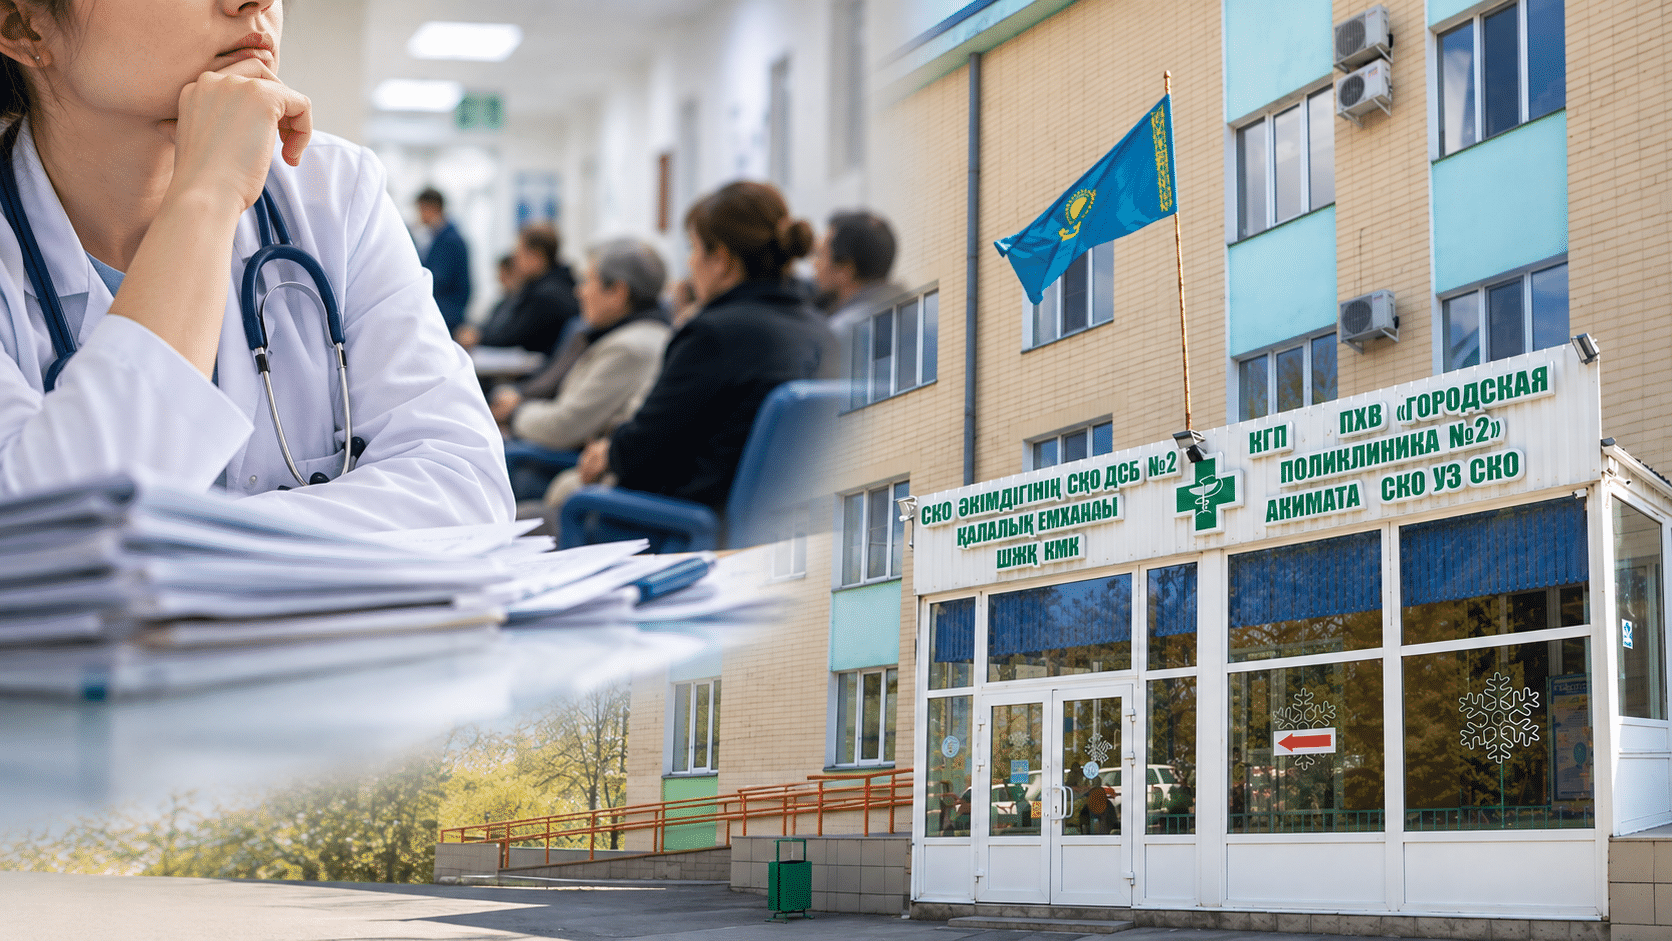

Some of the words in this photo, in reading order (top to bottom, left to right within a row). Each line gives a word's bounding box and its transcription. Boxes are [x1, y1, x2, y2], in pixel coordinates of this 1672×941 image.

[1250, 425, 1287, 454] КГП
[1340, 404, 1382, 434] ПХВ
[1397, 366, 1548, 421] «ГОРОДСКАЯ
[1281, 429, 1440, 483] ПОЛИКЛИНИКА
[1450, 417, 1501, 449] №2»
[921, 502, 952, 525] СКО
[958, 477, 1061, 517] ӘКІМДІГІНІҢ
[1104, 460, 1140, 490] ДСБ
[1148, 451, 1177, 477] №2
[1266, 484, 1361, 522] АКИМАТА
[1382, 471, 1425, 501] СКО
[1433, 464, 1461, 491] УЗ
[1470, 452, 1519, 483] СКО
[957, 513, 1035, 548] ҚАЛАЛЫҚ
[997, 543, 1038, 569] ШЖҚ
[1044, 536, 1080, 561] КМК
